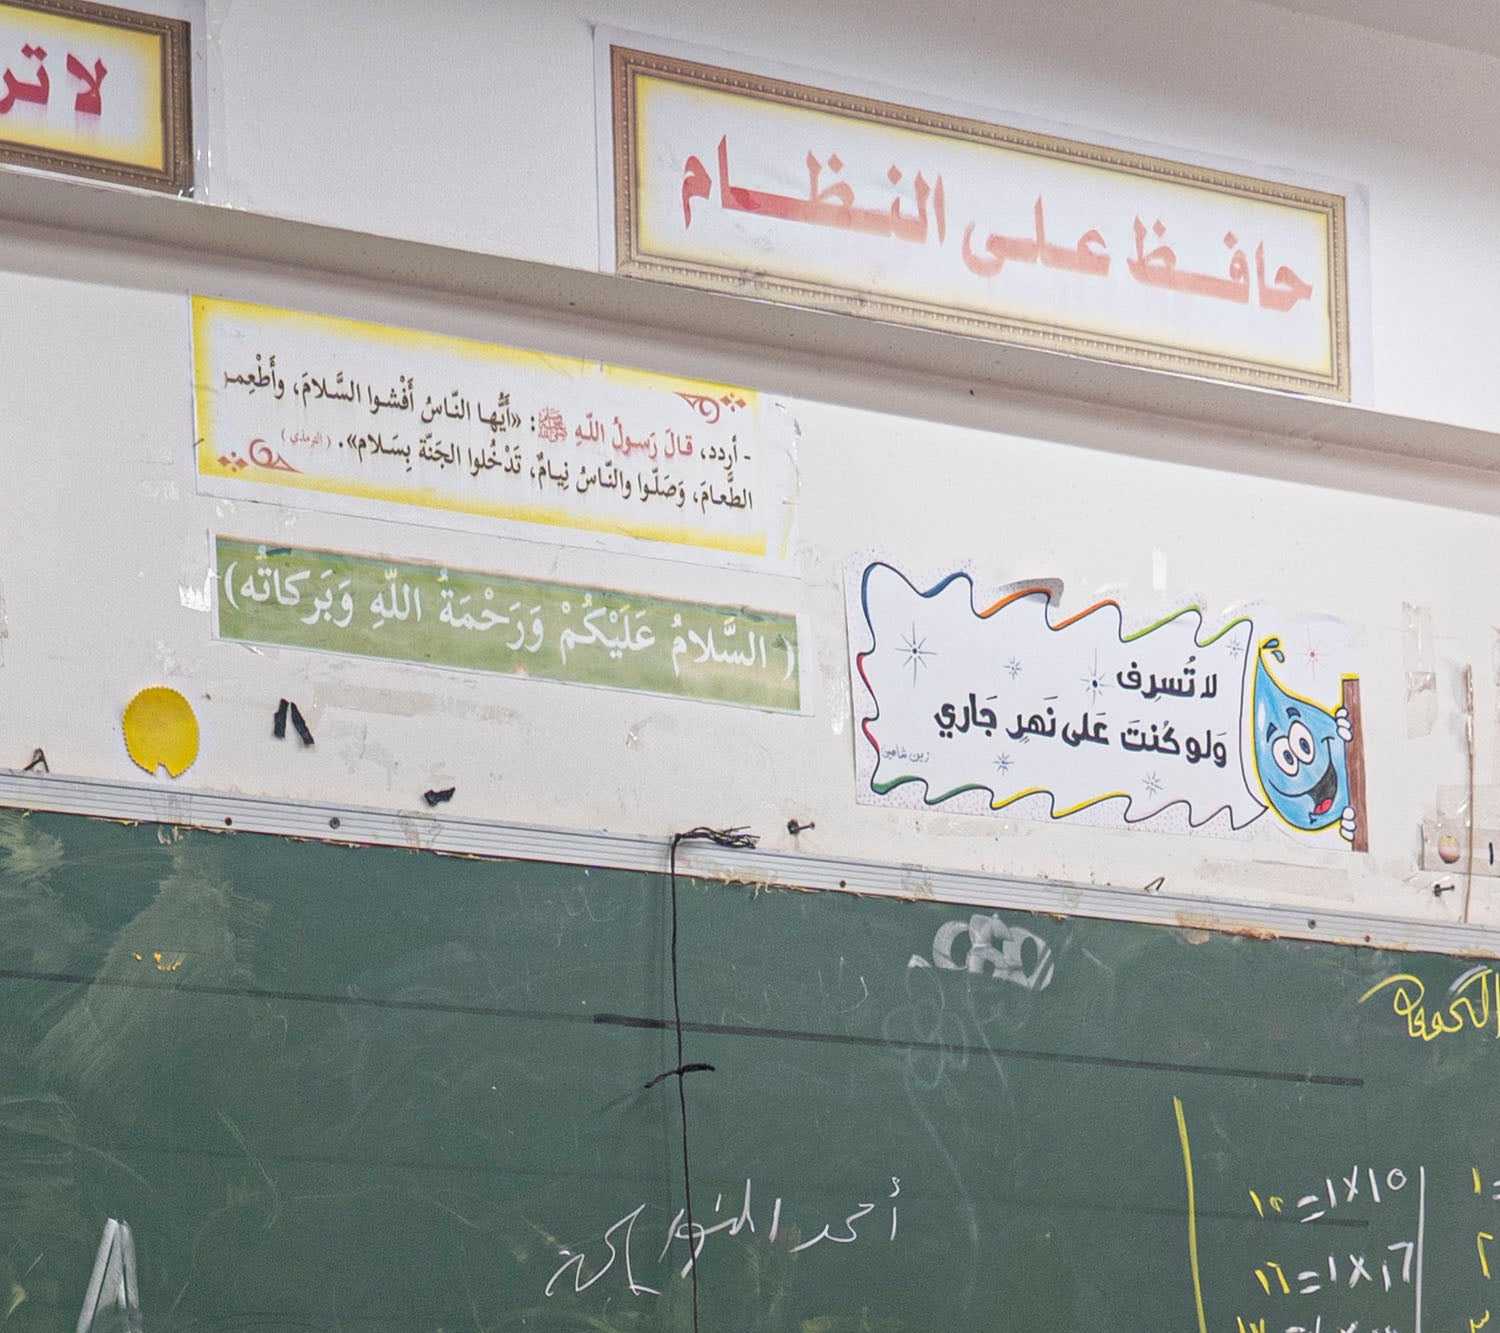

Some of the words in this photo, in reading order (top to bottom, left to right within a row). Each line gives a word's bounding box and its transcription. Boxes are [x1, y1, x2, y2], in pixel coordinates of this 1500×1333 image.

[64, 51, 108, 117] لا
[681, 133, 947, 248] النظام
[960, 196, 1111, 278] على
[1124, 214, 1314, 315] حافظ
[1199, 673, 1218, 699] لا
